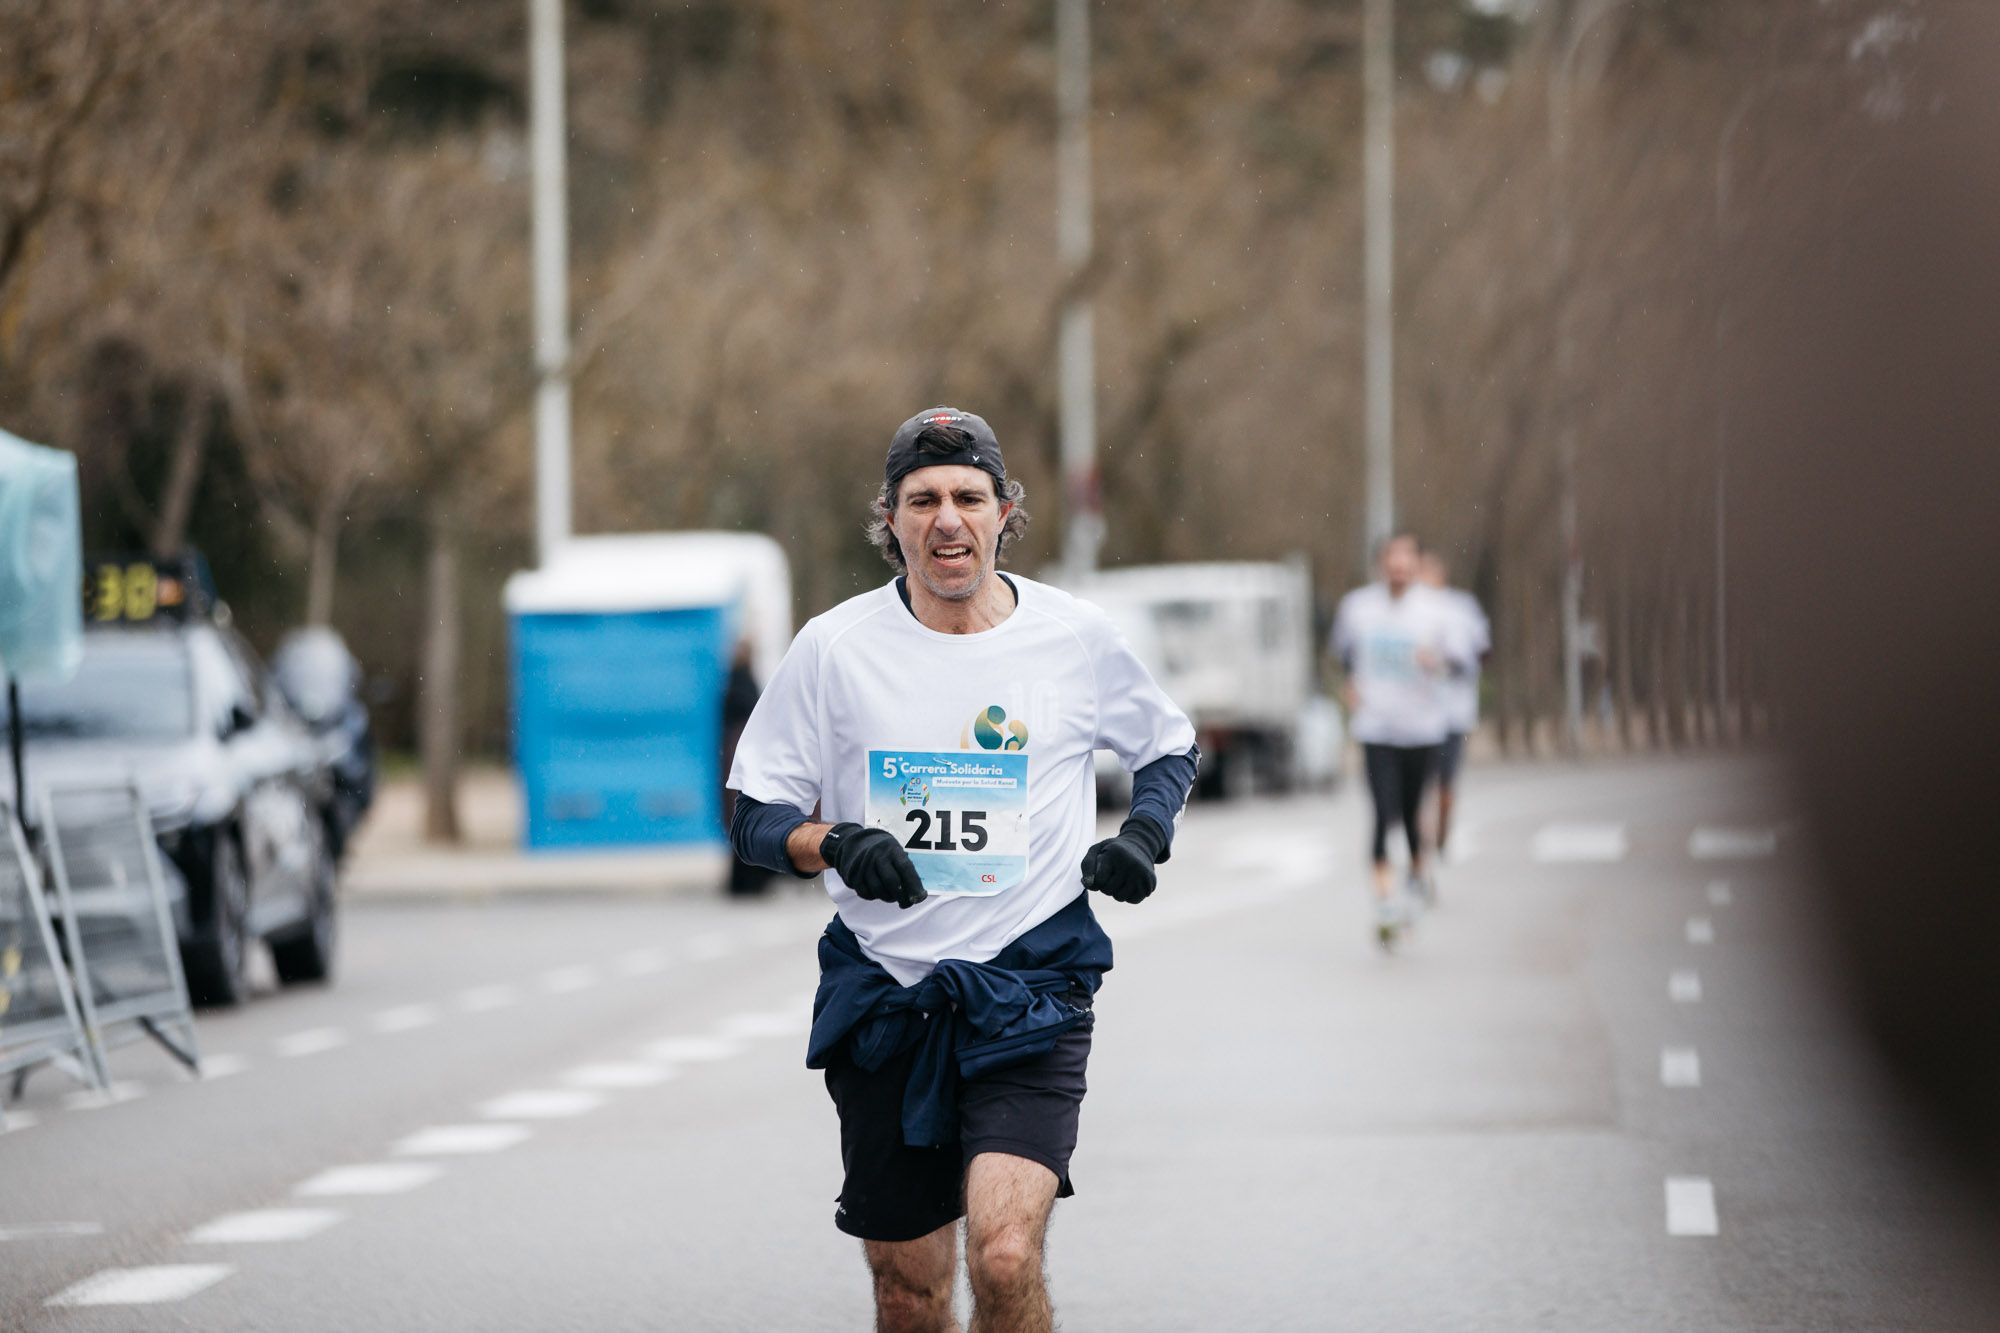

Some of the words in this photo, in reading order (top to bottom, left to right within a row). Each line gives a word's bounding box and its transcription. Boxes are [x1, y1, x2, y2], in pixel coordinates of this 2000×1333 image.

[901, 763, 947, 775] Carrera
[950, 763, 1003, 775] Solidaria
[905, 809, 988, 851] 215
[981, 874, 997, 883] CSL
